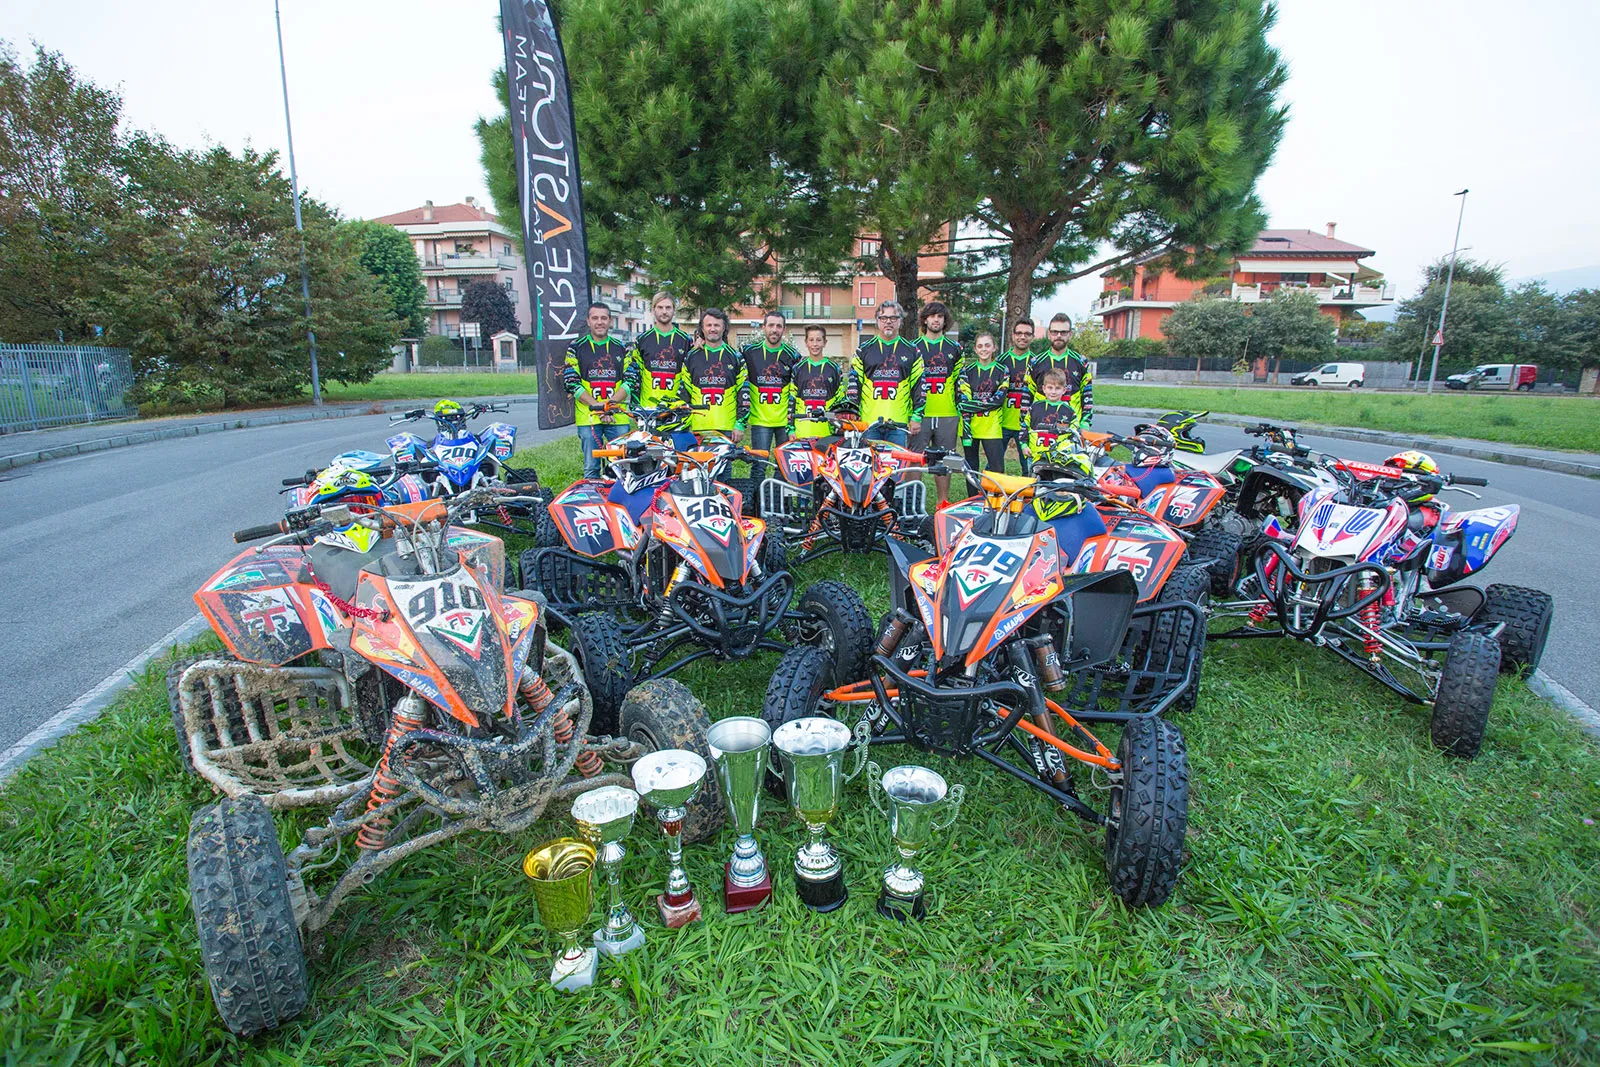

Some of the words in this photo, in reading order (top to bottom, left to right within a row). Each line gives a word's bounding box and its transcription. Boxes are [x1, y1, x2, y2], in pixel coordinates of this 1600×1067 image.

[441, 447, 476, 460] 200
[838, 450, 872, 466] 250
[1350, 462, 1398, 475] HONDA
[687, 498, 733, 526] 568
[949, 541, 1025, 578] 999
[409, 581, 487, 630] 910
[1003, 612, 1025, 633] MAPEI
